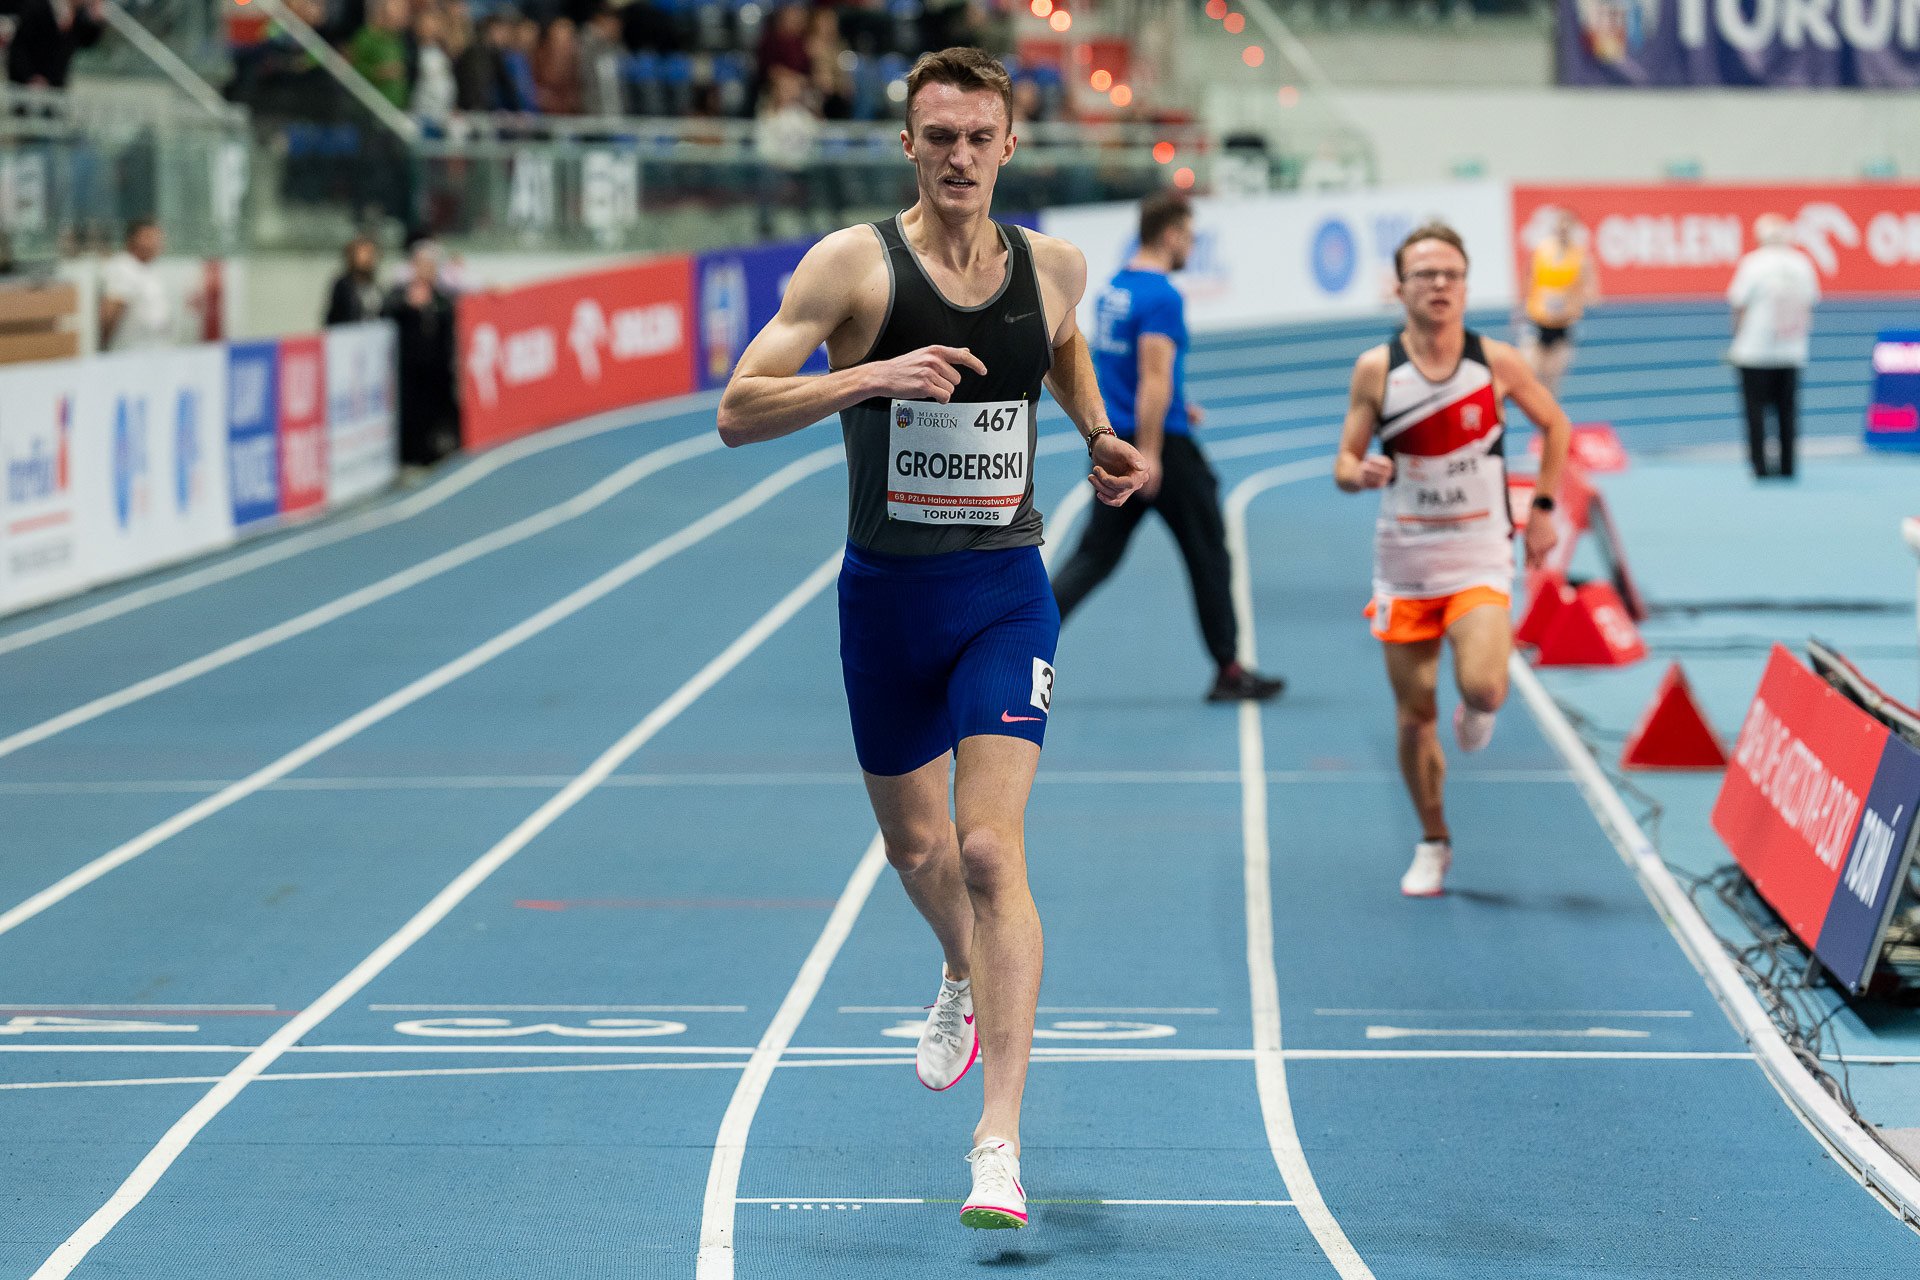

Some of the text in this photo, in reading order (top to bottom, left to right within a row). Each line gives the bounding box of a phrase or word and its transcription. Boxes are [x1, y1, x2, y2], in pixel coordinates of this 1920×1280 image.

[916, 416, 958, 429] TORUŃ
[973, 407, 1019, 432] 467
[896, 450, 1023, 480] GROBERSKI
[894, 493, 907, 501] 69.
[908, 495, 926, 503] PZLA
[927, 496, 958, 505] Halowe
[959, 497, 1005, 506] Mistrzostwa
[922, 507, 1000, 521] TORUŃ 2025
[1040, 667, 1054, 710] 3
